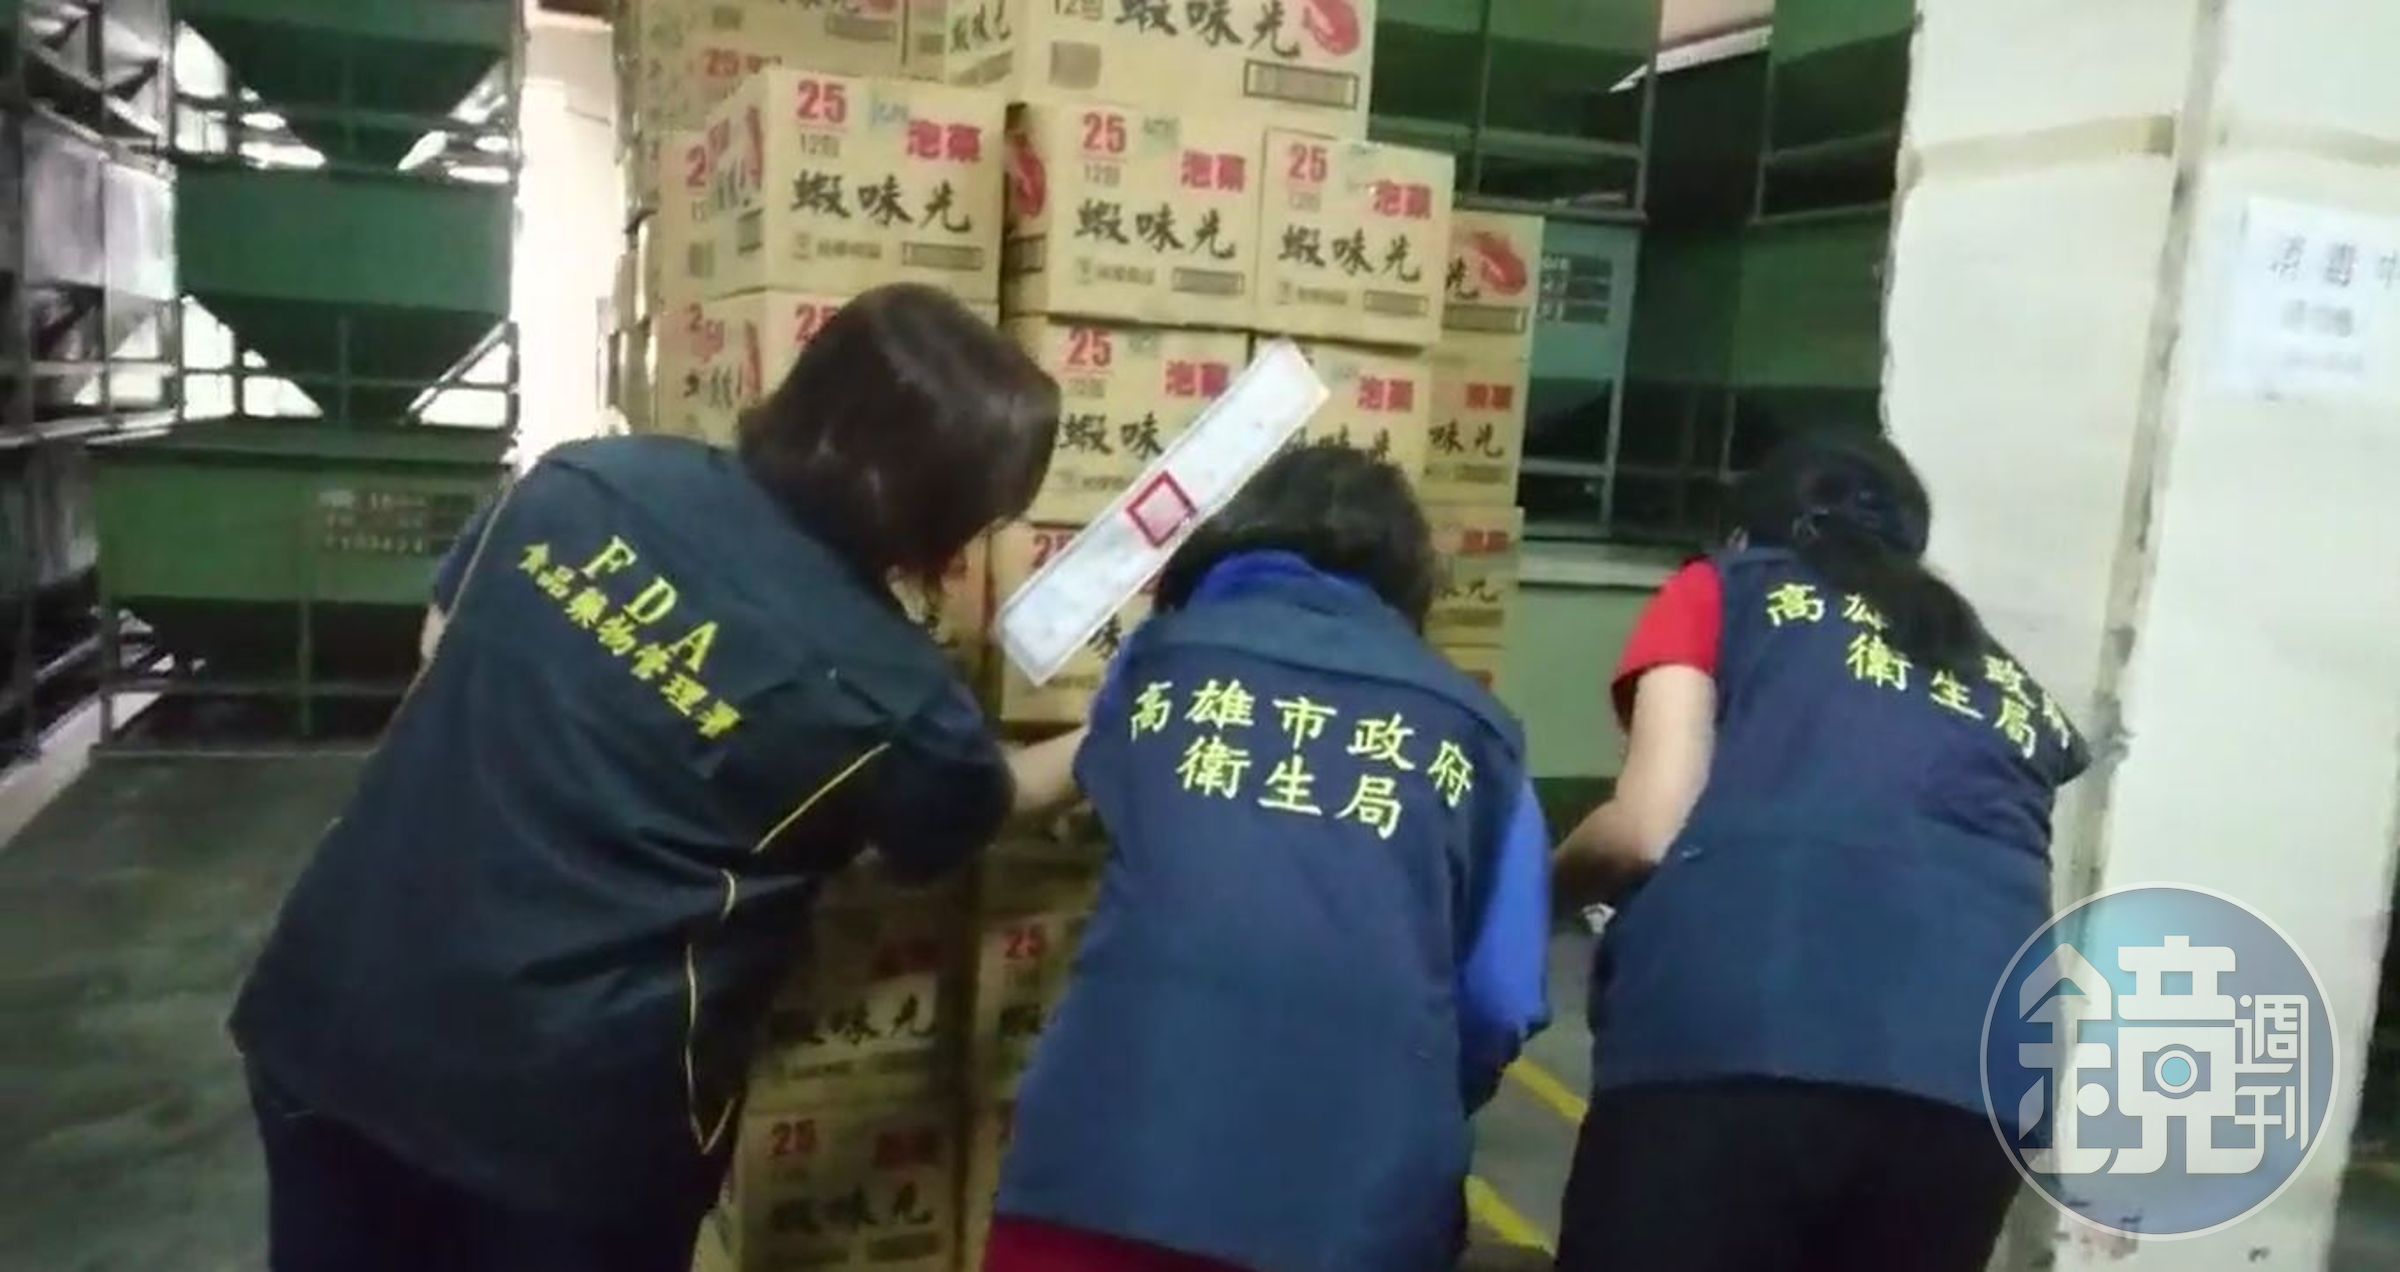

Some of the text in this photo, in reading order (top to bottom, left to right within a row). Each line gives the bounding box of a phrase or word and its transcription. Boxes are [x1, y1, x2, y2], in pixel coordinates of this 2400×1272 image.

[798, 80, 847, 124] 25
[1082, 112, 1127, 154] 25
[1288, 143, 1328, 183] 25
[1067, 326, 1112, 368] 25
[582, 535, 718, 673] FDA
[1845, 632, 2037, 760] 衛生局
[1129, 678, 1475, 809] 高雄市政府
[1175, 735, 1402, 840] 衛生局
